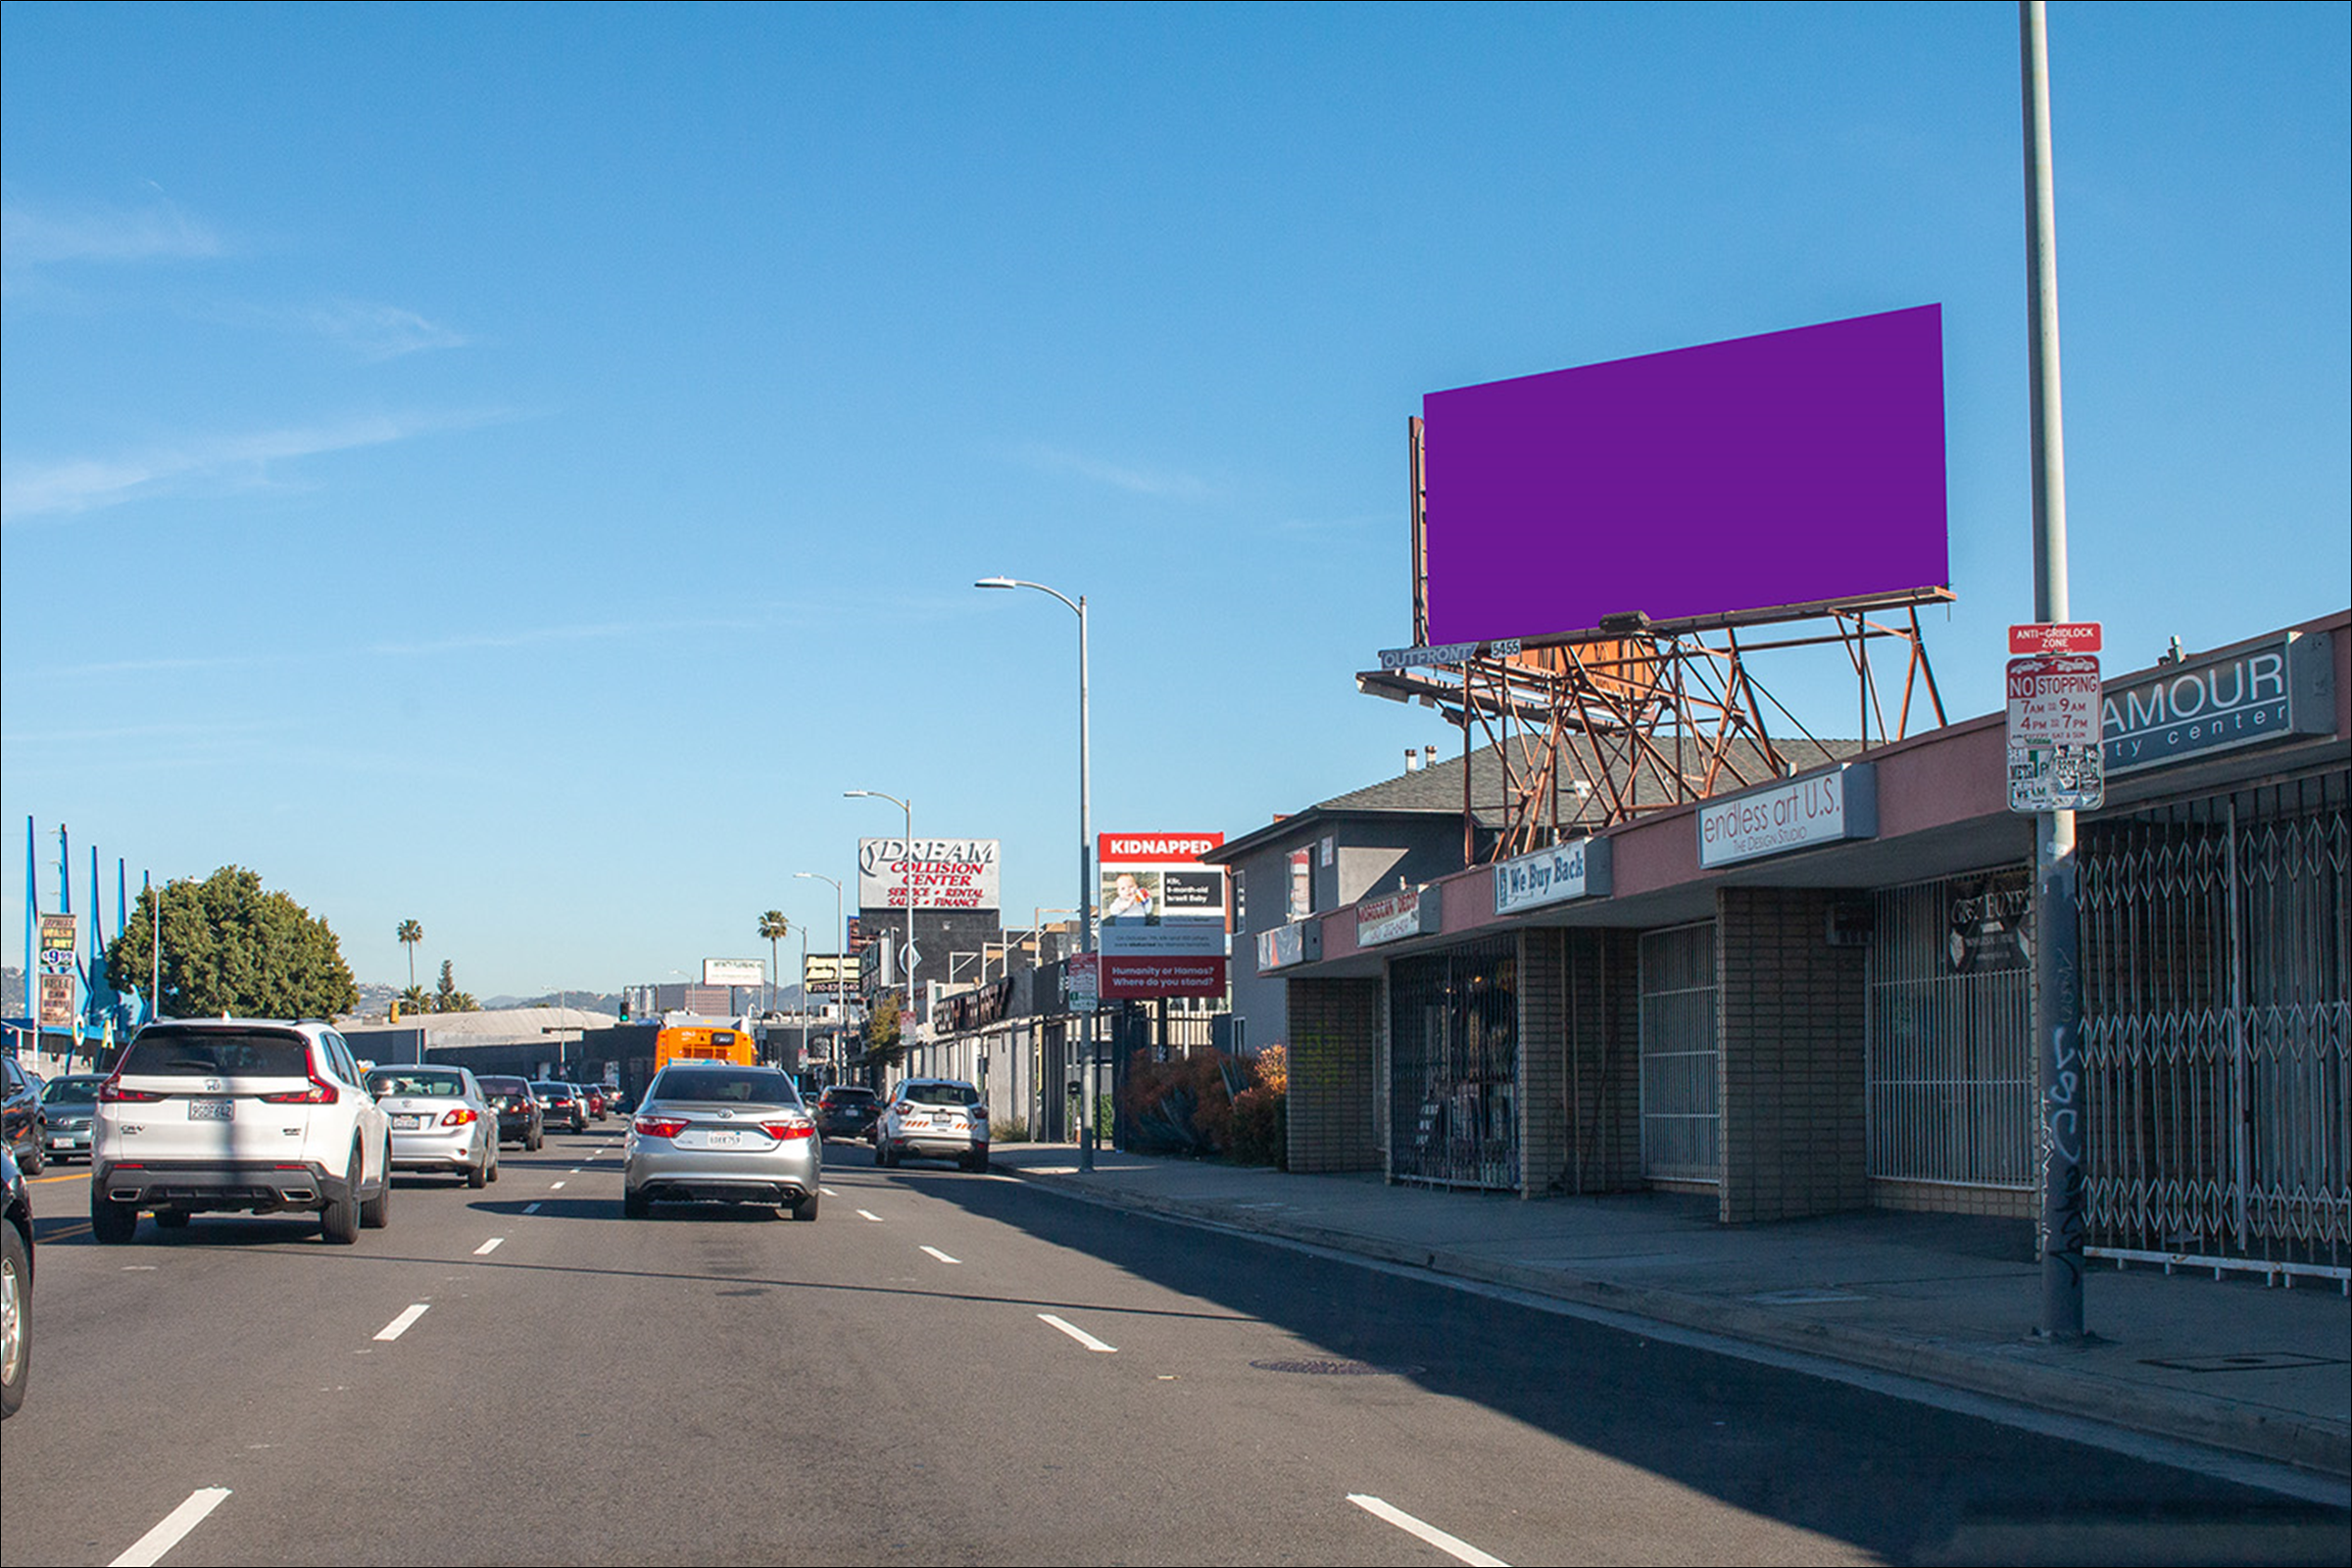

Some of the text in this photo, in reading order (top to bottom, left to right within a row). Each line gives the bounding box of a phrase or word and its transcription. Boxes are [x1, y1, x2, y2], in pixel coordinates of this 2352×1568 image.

[2016, 628, 2094, 639] ANTI-GRIDLOCK
[1493, 642, 1519, 658] 5455
[2042, 638, 2070, 648] ZONE
[1384, 648, 1471, 667] OUTFRONT
[2009, 675, 2097, 697] NO STOPPING
[2167, 705, 2285, 745] center
[1703, 777, 1840, 844] endless art U.S.
[1733, 825, 1808, 855] THE DESIGN STUDIO
[879, 840, 995, 863] DREAM
[1110, 840, 1213, 855] KIDNAPPED
[891, 861, 984, 875] COLLISION
[1510, 867, 1527, 894] We
[1529, 863, 1552, 895] Buy
[1553, 851, 1585, 883] Back
[903, 874, 972, 886] CENTER
[887, 887, 985, 897] SERICE RENTAL
[888, 897, 979, 906] SALS FINANCE
[42, 929, 73, 938] WASH
[53, 939, 73, 948] DRY
[1111, 966, 1160, 977] Humanity
[1174, 966, 1214, 975] Hamas?
[1112, 978, 1145, 987] Where
[1160, 980, 1180, 989] you
